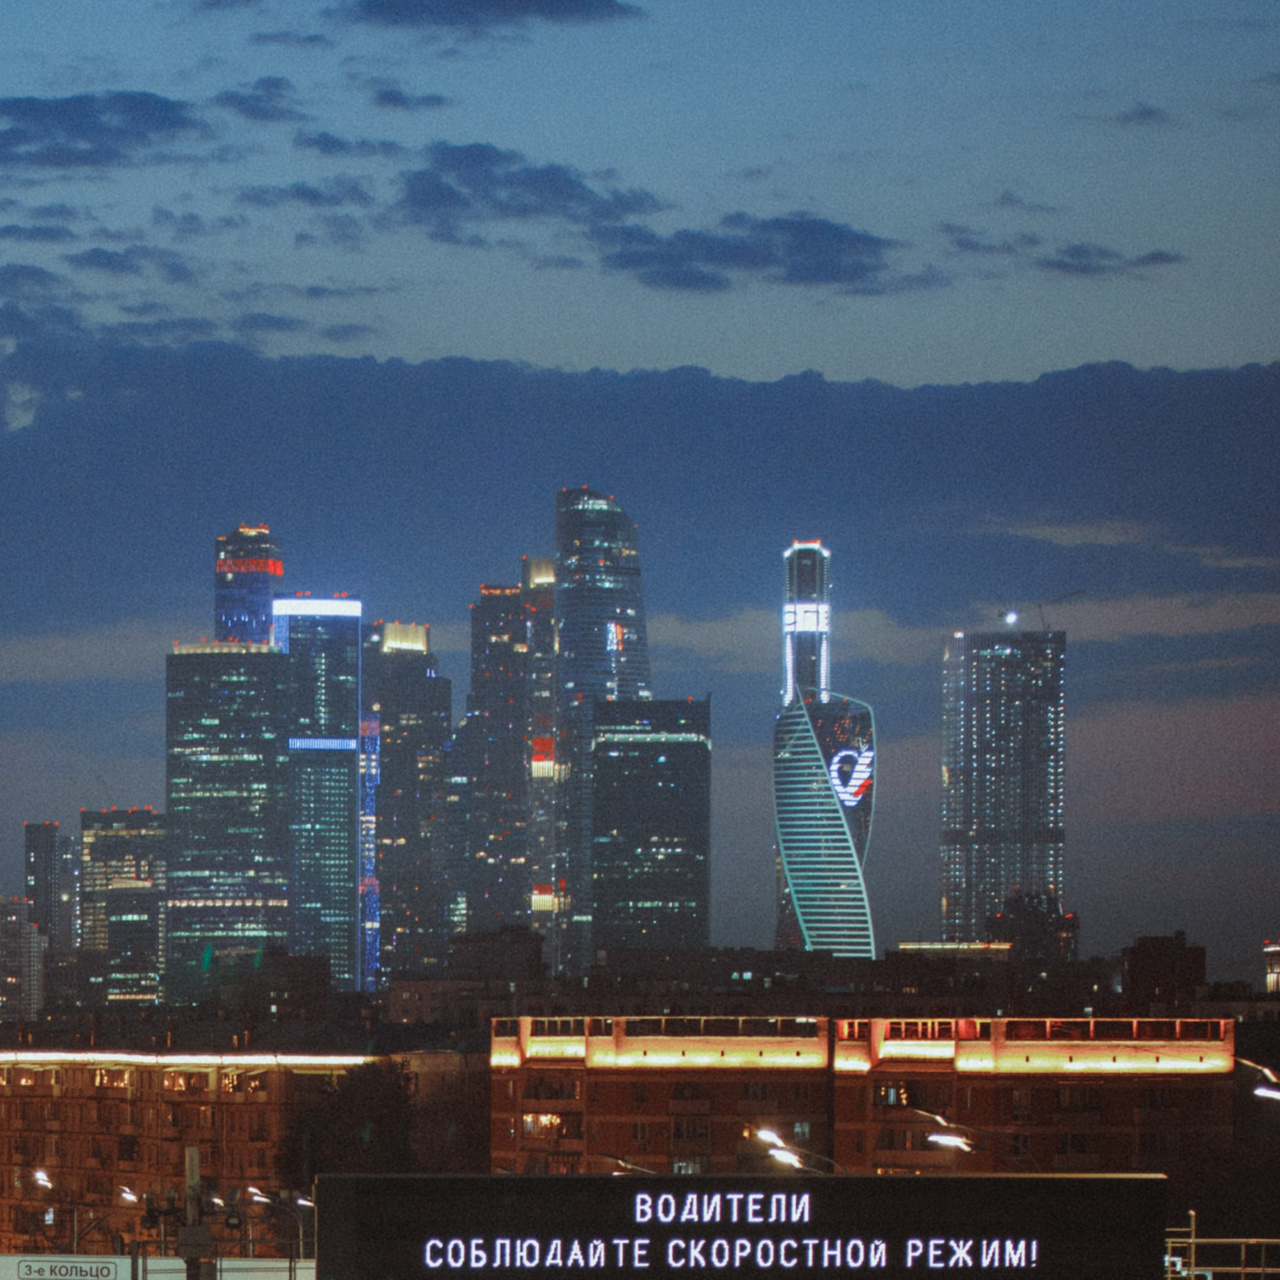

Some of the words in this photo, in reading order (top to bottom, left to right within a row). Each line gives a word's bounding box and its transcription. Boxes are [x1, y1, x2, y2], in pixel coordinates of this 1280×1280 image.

[634, 1192, 811, 1224] ВОДИТЕЛИ
[423, 1237, 651, 1269] СОБЛЮДАЙТЕ
[666, 1237, 887, 1269] СКОРОСТНОЙ
[905, 1237, 1039, 1269] РЕЖИМ!
[24, 1264, 45, 1277] 3-е
[49, 1265, 111, 1279] КОЛЬЦО
